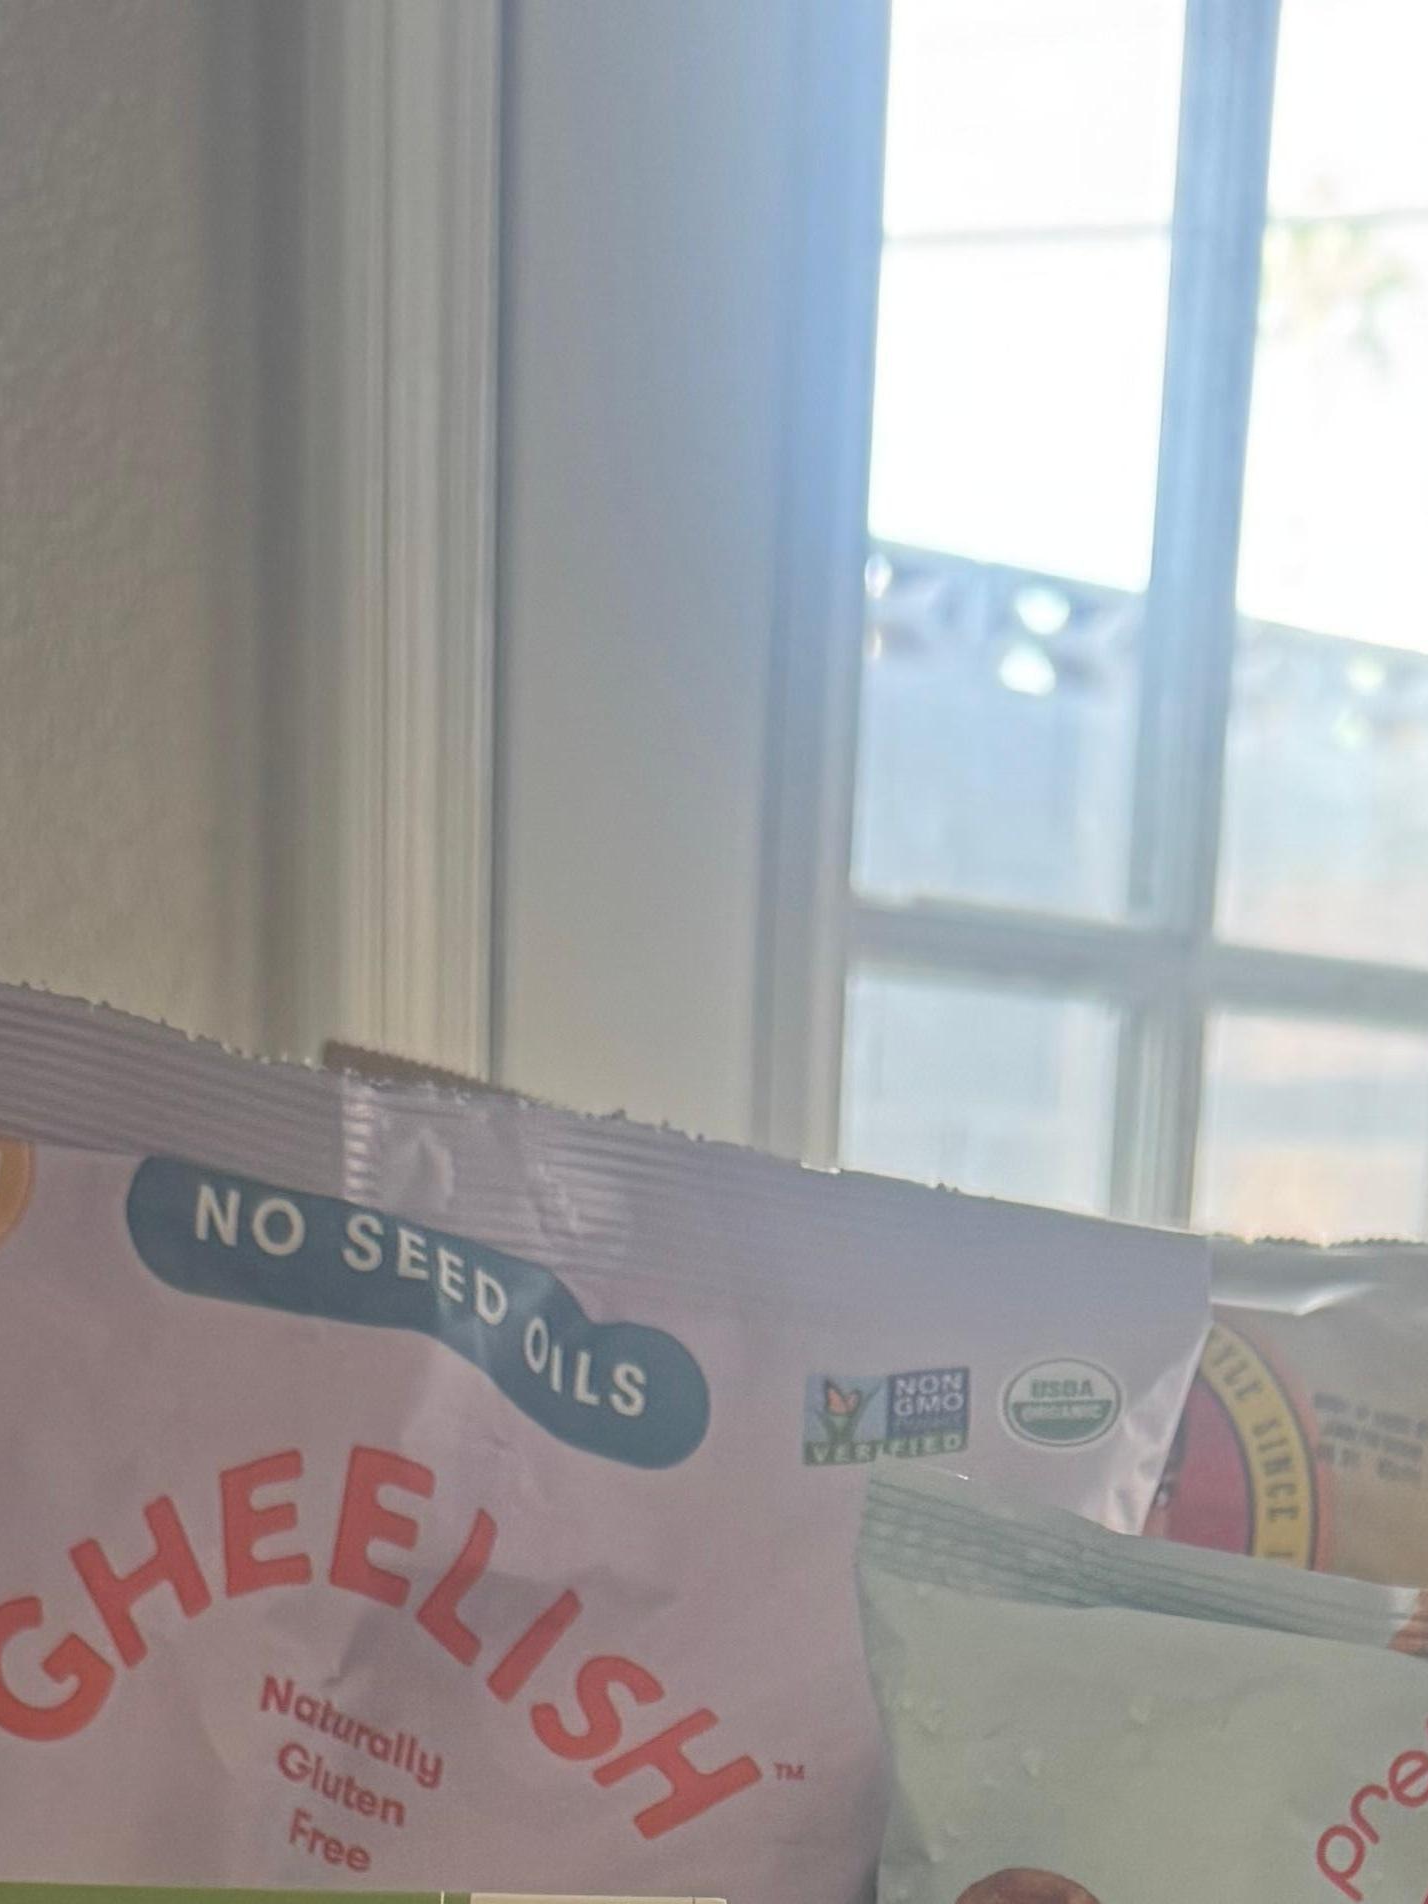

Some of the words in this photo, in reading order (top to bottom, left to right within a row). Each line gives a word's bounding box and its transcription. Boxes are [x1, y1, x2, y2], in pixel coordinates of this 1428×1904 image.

[195, 1183, 305, 1255] NO
[342, 1214, 508, 1325] SEED
[524, 1318, 646, 1417] OILS
[893, 1393, 965, 1416] GMO
[895, 1374, 963, 1396] NON
[1031, 1379, 1094, 1399] USDA
[259, 1675, 443, 1789] Naturally
[277, 1741, 406, 1827] Gluten
[288, 1808, 371, 1873] Free
